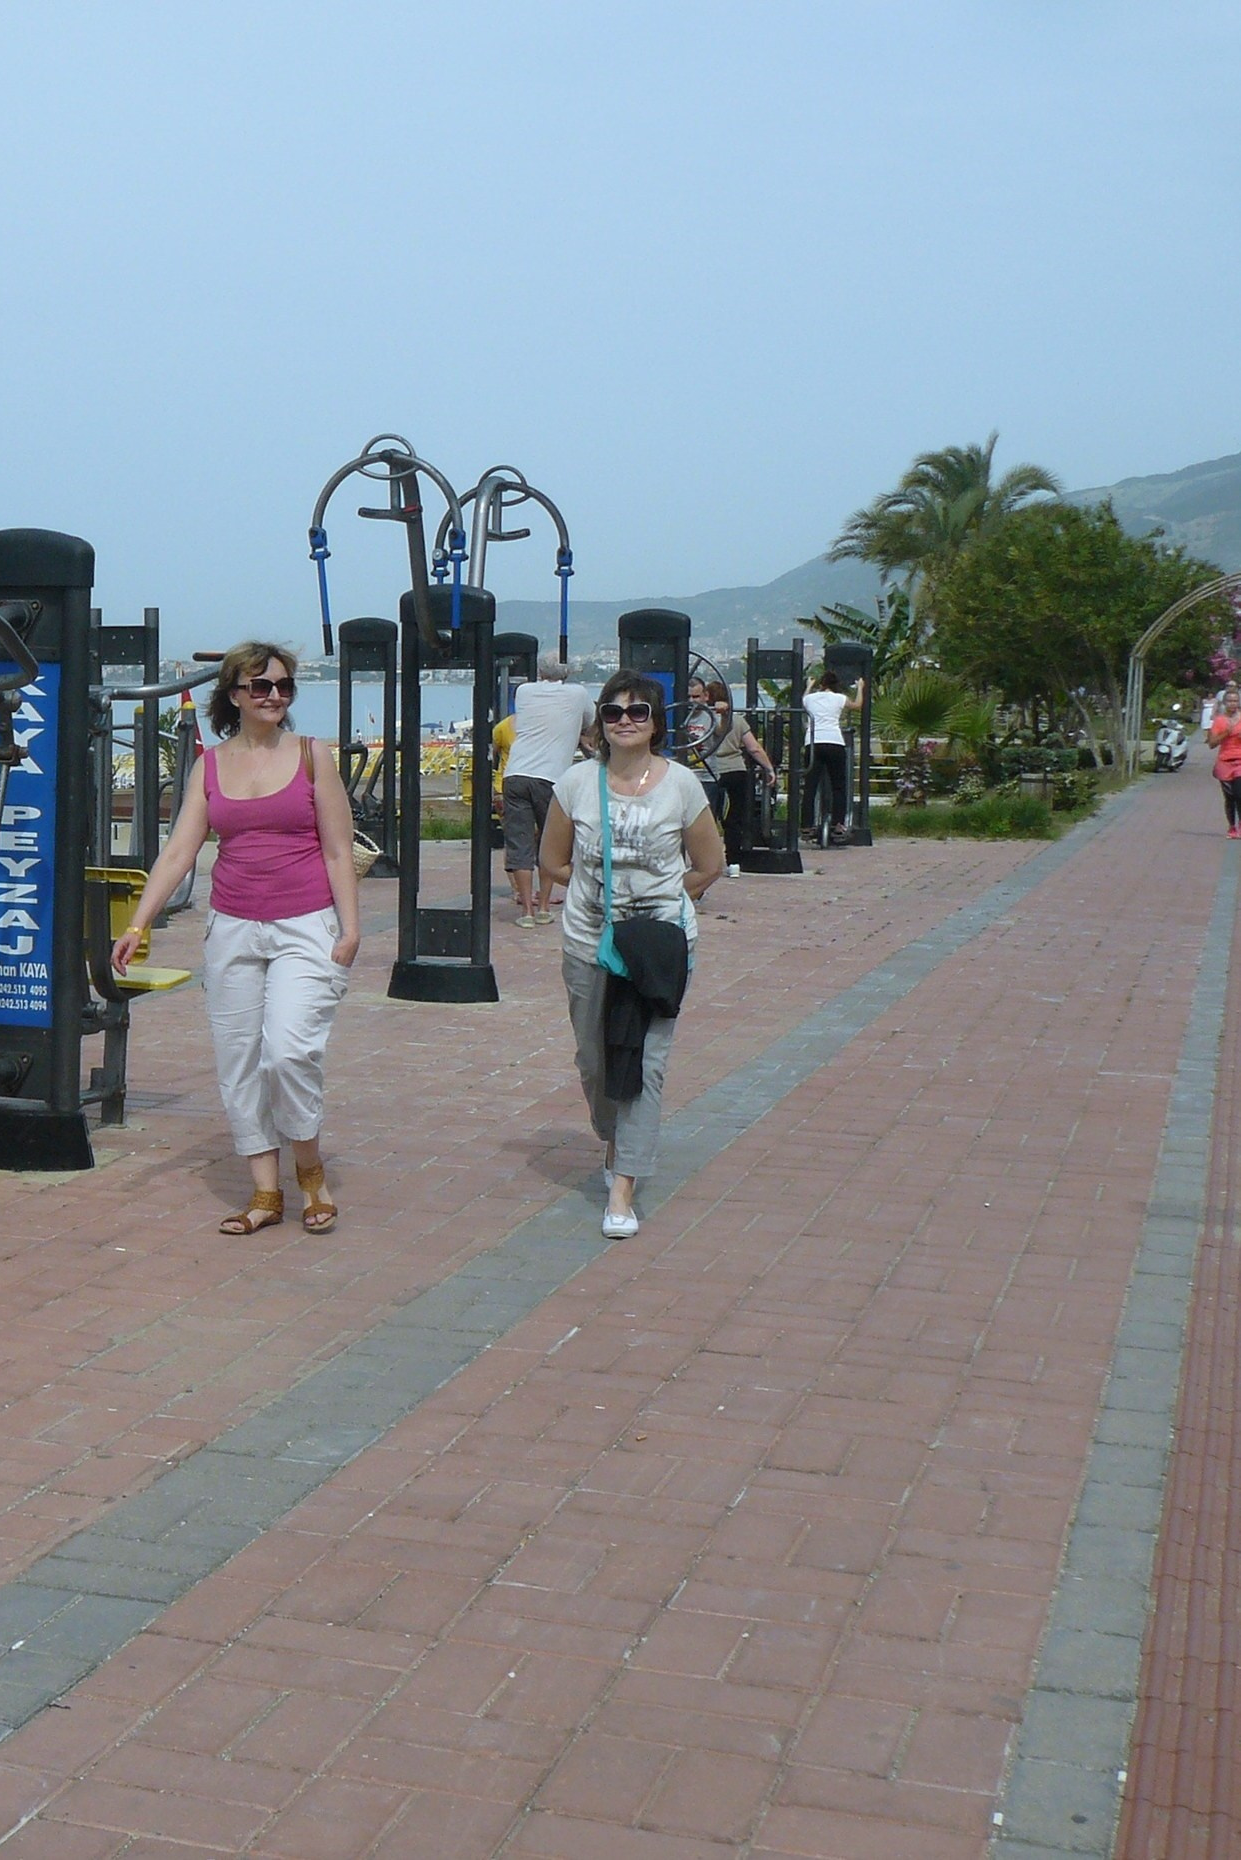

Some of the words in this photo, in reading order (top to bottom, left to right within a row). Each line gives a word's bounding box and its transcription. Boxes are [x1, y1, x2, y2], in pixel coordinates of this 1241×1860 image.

[19, 962, 48, 979] KAYA
[30, 985, 47, 997] 4095
[29, 1000, 47, 1012] 4094
